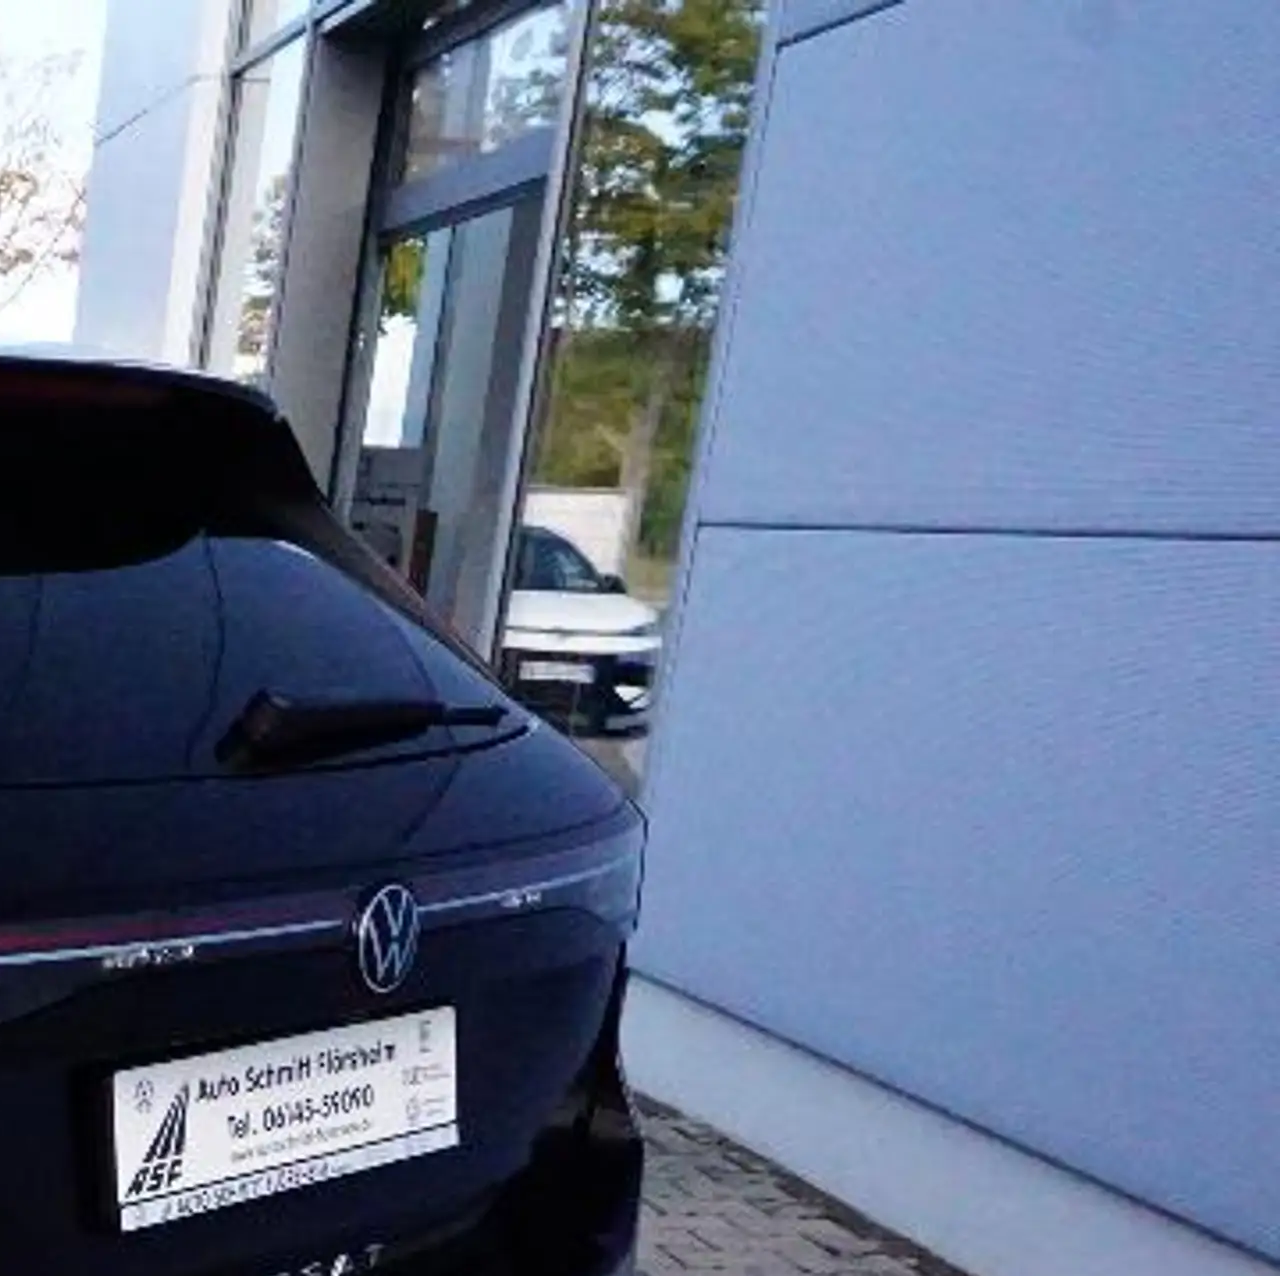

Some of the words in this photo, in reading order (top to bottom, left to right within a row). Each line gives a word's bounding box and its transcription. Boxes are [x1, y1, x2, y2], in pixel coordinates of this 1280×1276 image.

[196, 1074, 240, 1102] Auto
[244, 1055, 311, 1092] Schmitt
[124, 1158, 183, 1199] ASF
